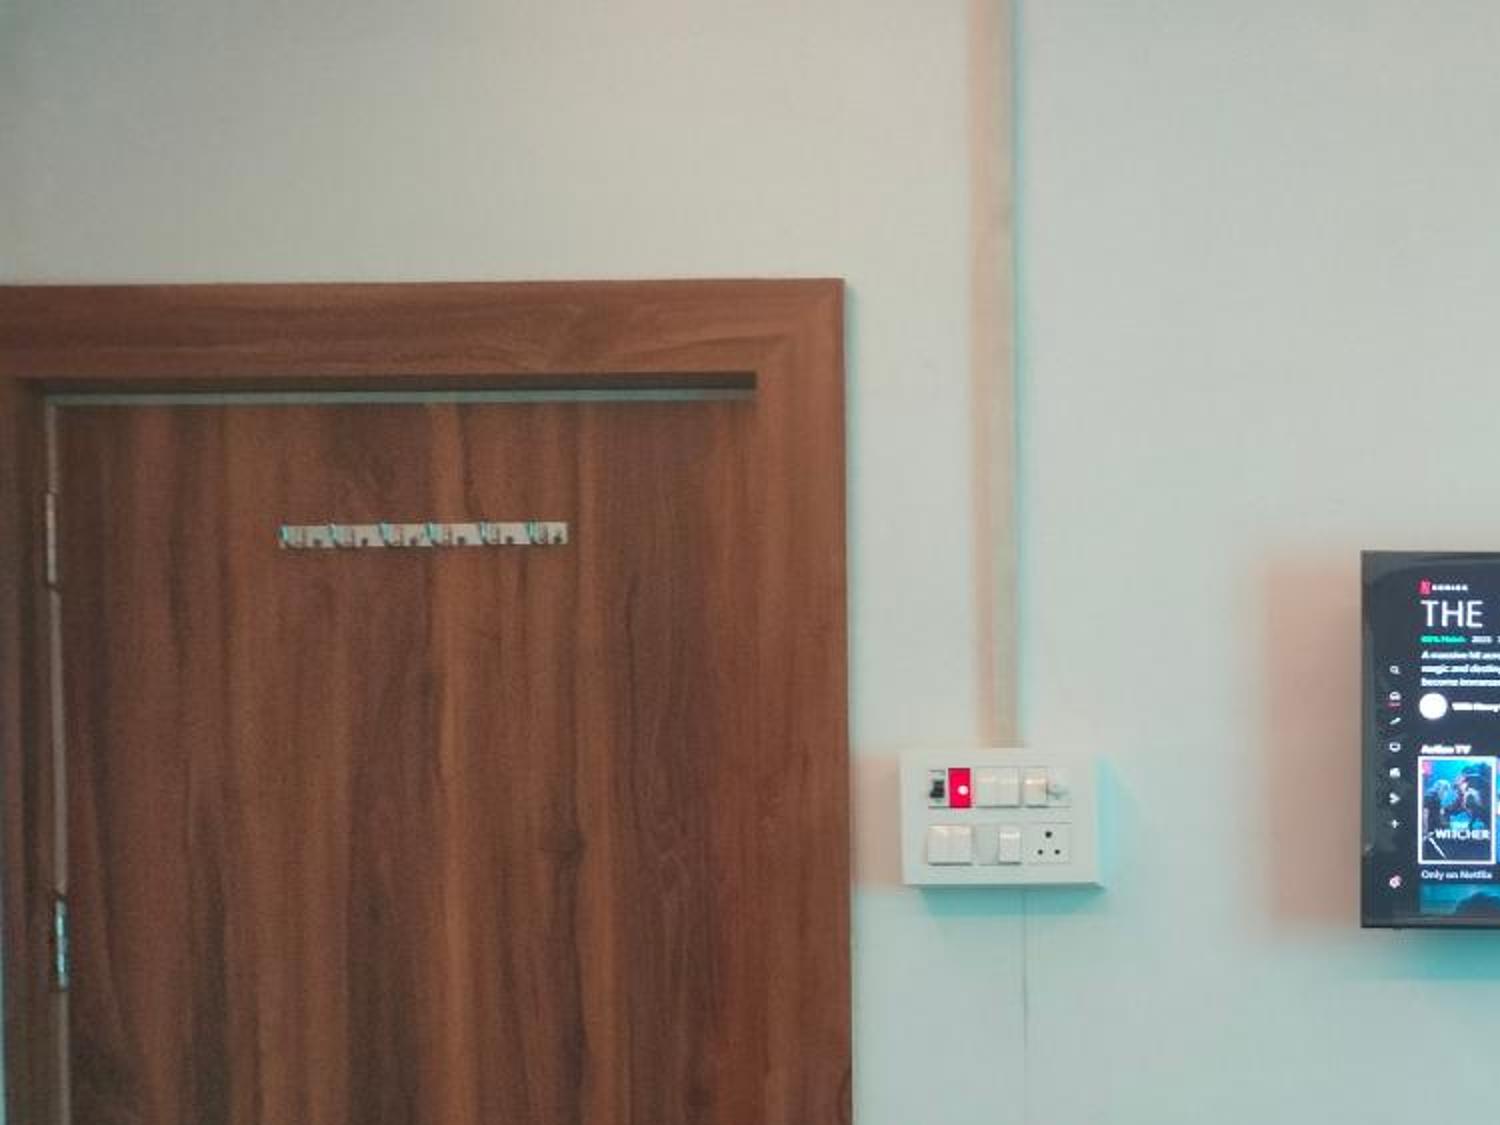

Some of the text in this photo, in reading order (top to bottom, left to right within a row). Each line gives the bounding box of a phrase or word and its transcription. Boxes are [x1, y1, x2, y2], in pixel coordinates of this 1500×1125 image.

[1420, 600, 1483, 628] THE
[1455, 745, 1472, 754] TV
[1434, 829, 1489, 840] WITCHER
[1421, 869, 1444, 880] Only
